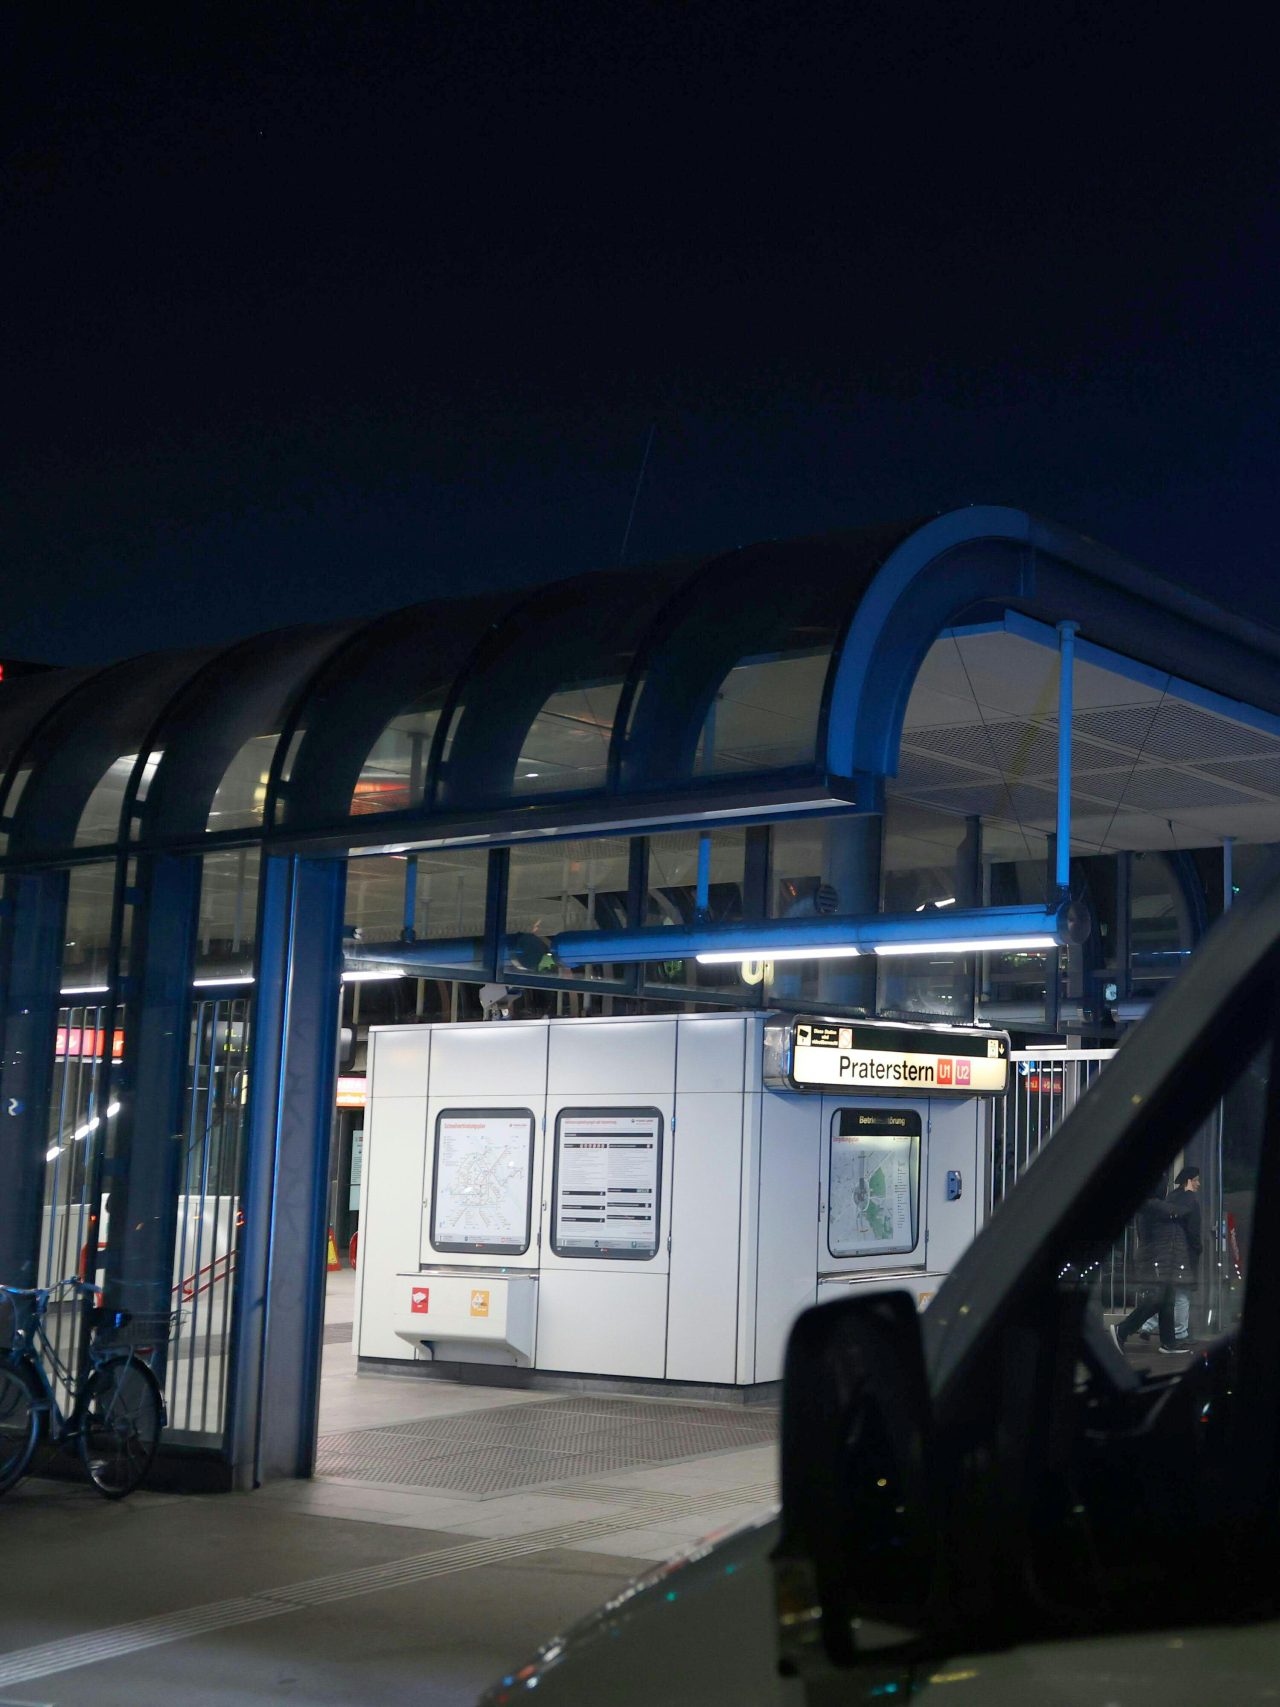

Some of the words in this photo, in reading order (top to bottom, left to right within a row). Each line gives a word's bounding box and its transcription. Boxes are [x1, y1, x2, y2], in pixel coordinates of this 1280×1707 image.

[839, 1055, 934, 1082] Praterstern
[939, 1063, 951, 1079] U1
[956, 1064, 969, 1080] U2
